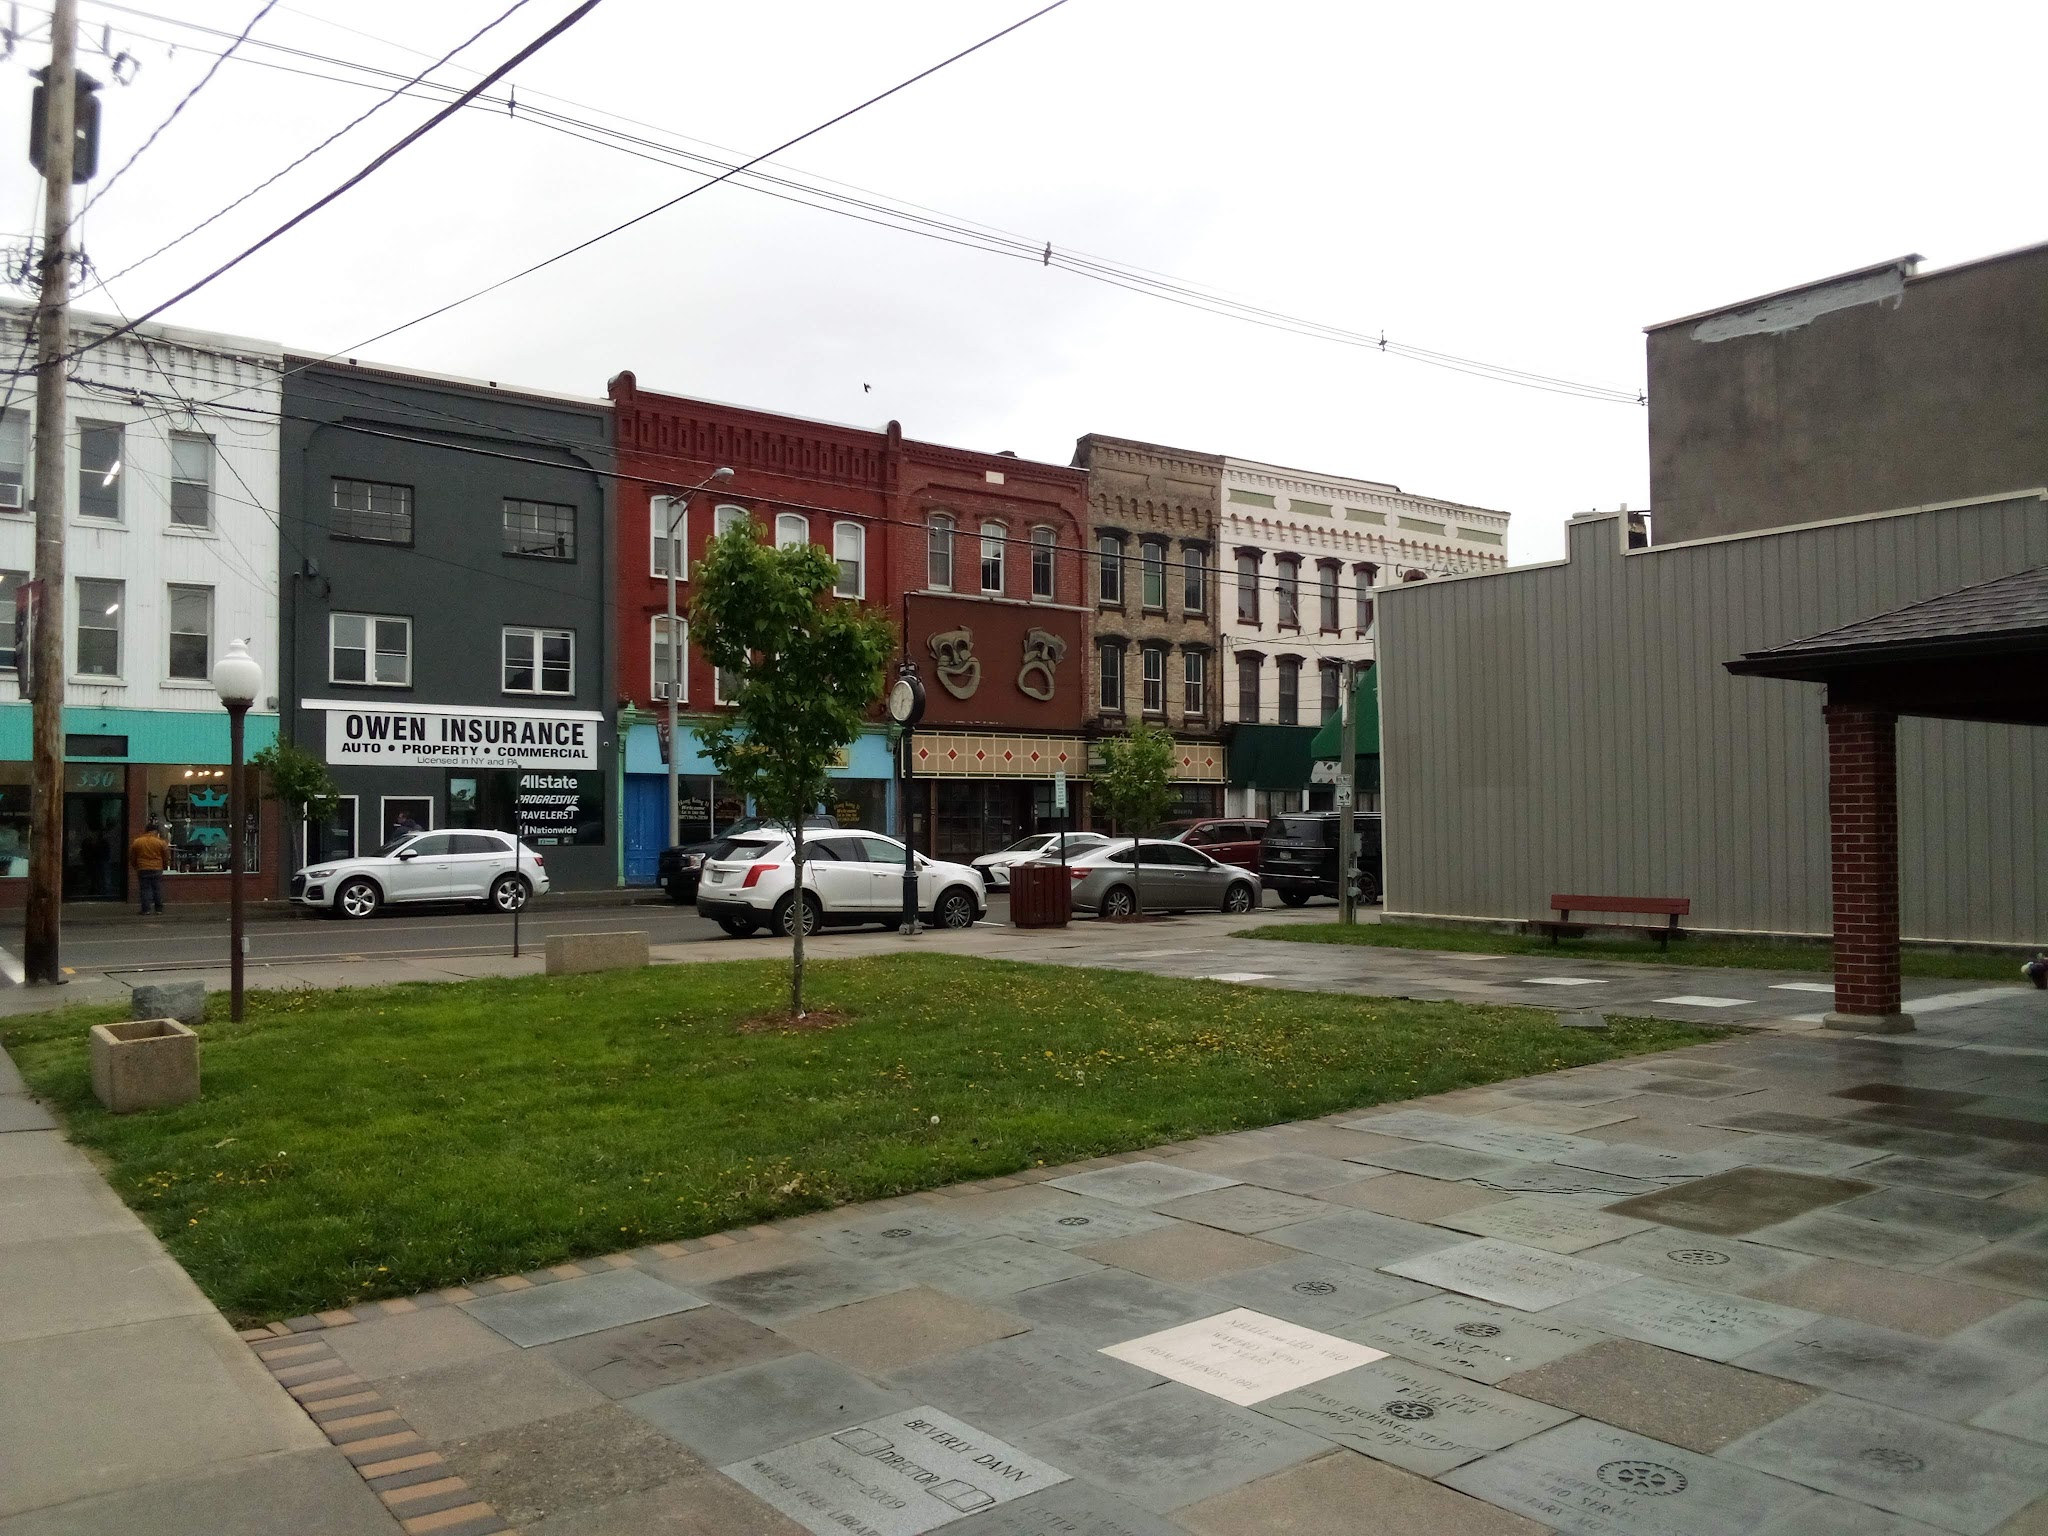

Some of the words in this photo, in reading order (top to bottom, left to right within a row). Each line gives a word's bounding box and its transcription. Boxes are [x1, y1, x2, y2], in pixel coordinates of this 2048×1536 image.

[346, 714, 425, 741] OWEN
[441, 718, 584, 746] INSURANCE
[341, 743, 381, 753] AUTO
[402, 744, 478, 756] PROPERTY
[497, 747, 589, 759] COMMERCIAL
[417, 756, 458, 765] Licensed
[461, 757, 469, 765] in
[487, 758, 504, 766] and
[507, 758, 518, 766] PA
[76, 770, 114, 788] 330
[520, 774, 578, 789] Allstate
[529, 826, 578, 834] Nationwide
[1226, 1319, 1271, 1337] NELLIE
[1292, 1335, 1316, 1350] LEO
[1140, 1345, 1175, 1361] FROM
[1210, 1331, 1261, 1352] WAVERLY
[1269, 1349, 1304, 1366] NEWS
[1232, 1347, 1272, 1366] YEARS
[1297, 1389, 1344, 1407] ROTARY
[1343, 1406, 1414, 1434] EXCHANGE
[903, 1418, 977, 1455] BEVERLY
[972, 1453, 1034, 1483] DANN
[873, 1448, 942, 1487] DIRECTOR
[828, 1510, 882, 1536] LIBRAR
